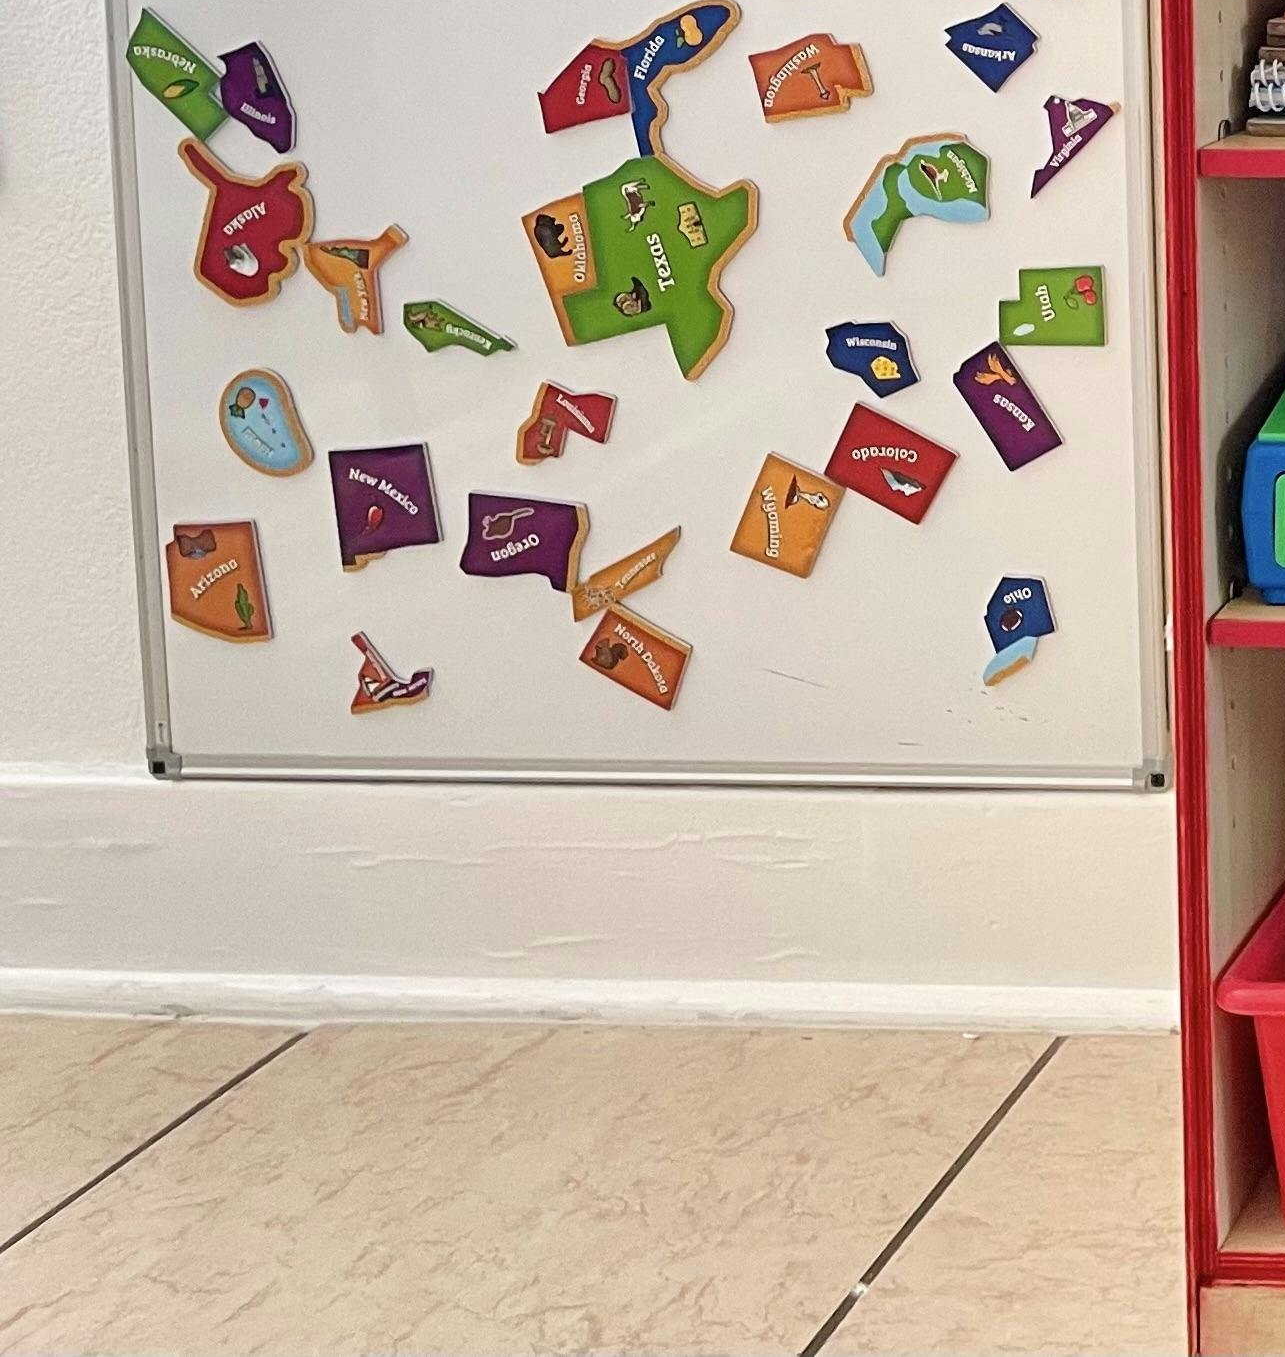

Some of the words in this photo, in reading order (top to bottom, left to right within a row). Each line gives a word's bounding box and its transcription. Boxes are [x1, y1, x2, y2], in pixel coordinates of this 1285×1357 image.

[133, 45, 197, 74] Nebraska
[634, 34, 664, 81] Florida
[962, 42, 1016, 62] Arkansas
[576, 64, 593, 105] Georgia
[763, 44, 820, 109] Washington
[1050, 133, 1084, 169] Virginia
[947, 150, 979, 193] Michigan
[224, 201, 266, 235] Alaska
[571, 213, 587, 282] Oklahoma
[646, 234, 675, 292] Texas
[1038, 285, 1056, 322] Utah
[846, 336, 898, 351] Wisconsin
[992, 393, 1037, 432] Kansas
[851, 446, 918, 463] Colorado
[349, 467, 378, 486] New
[378, 479, 419, 516] Mexico
[761, 486, 780, 558] Wyoming
[490, 533, 540, 562] Oregon
[190, 558, 238, 600] Arizona
[1003, 587, 1032, 604] Ohio
[614, 623, 644, 657] North
[642, 651, 669, 695] Dakota
